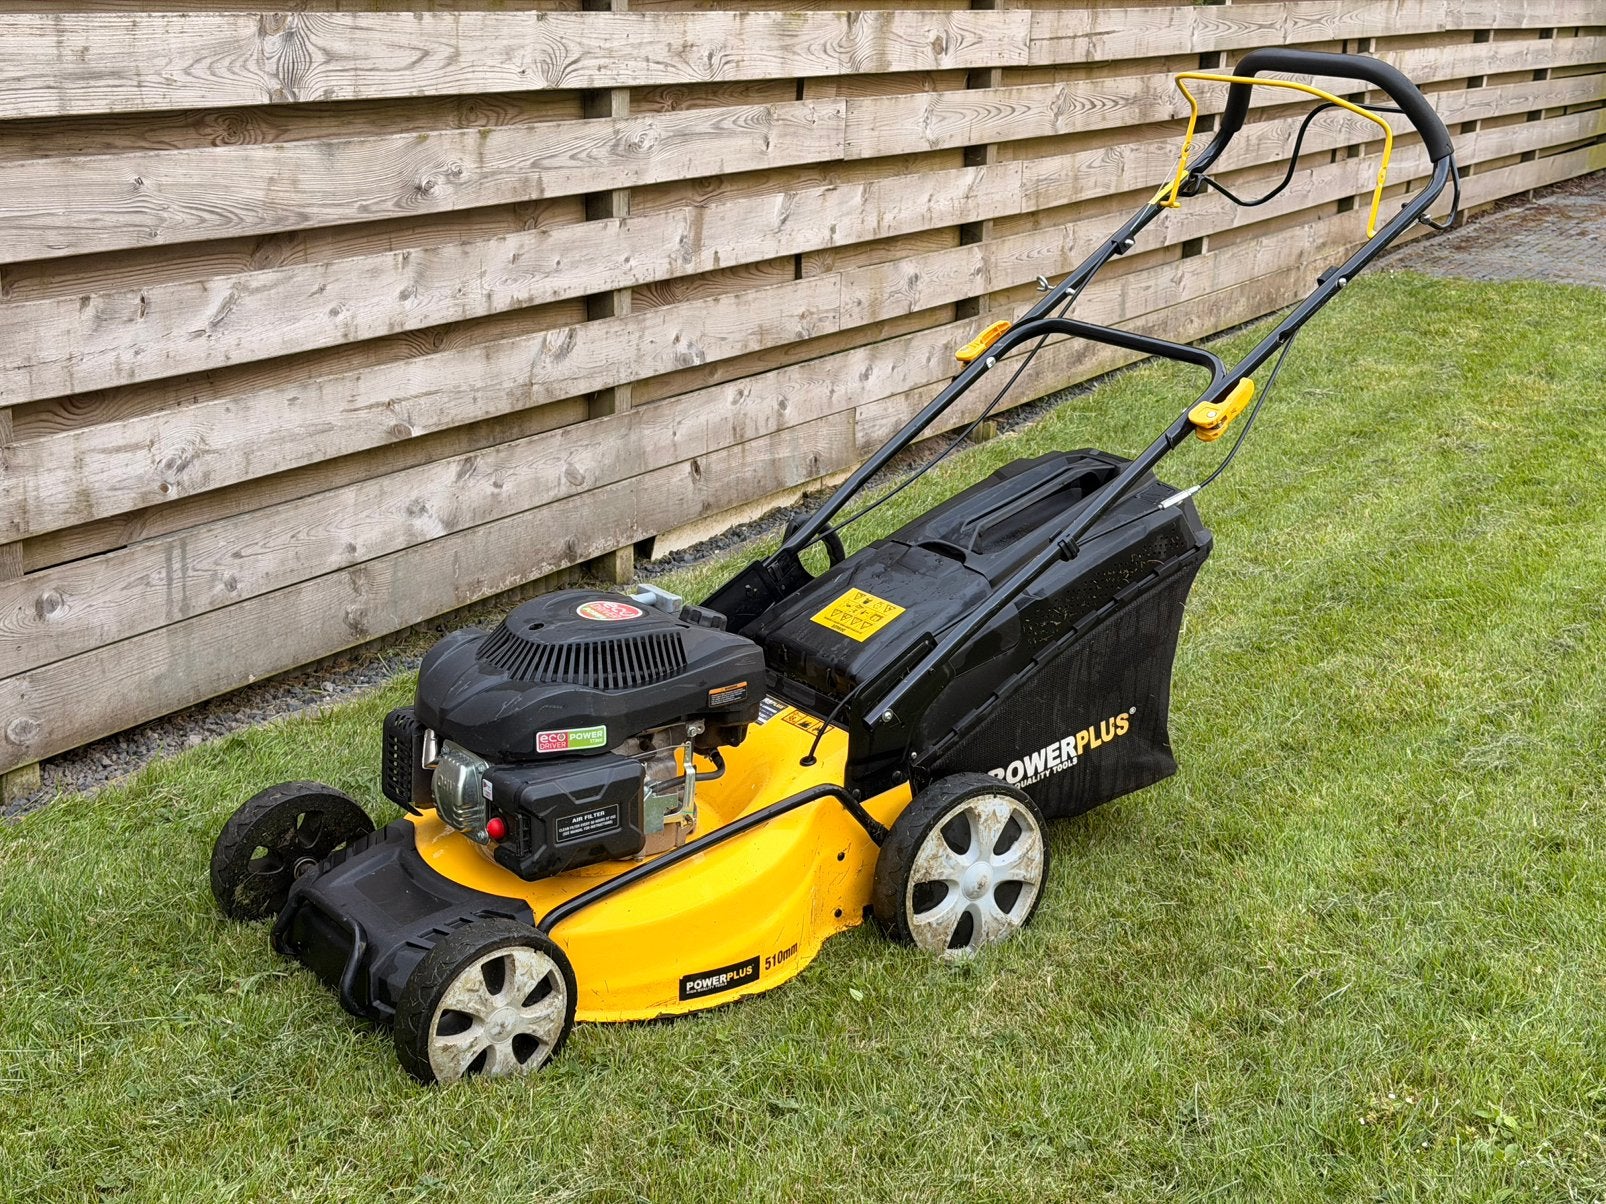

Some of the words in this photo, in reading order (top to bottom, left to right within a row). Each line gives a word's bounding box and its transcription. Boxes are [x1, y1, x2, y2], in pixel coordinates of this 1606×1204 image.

[540, 734, 566, 743] eco
[570, 731, 603, 741] POWER
[540, 742, 567, 750] DRIVER
[1015, 769, 1051, 790] QUALITY
[1053, 757, 1078, 774] TOOLS
[585, 811, 605, 820] FILTER
[765, 943, 798, 971] 510mm
[686, 965, 753, 991] POWERPLUS
